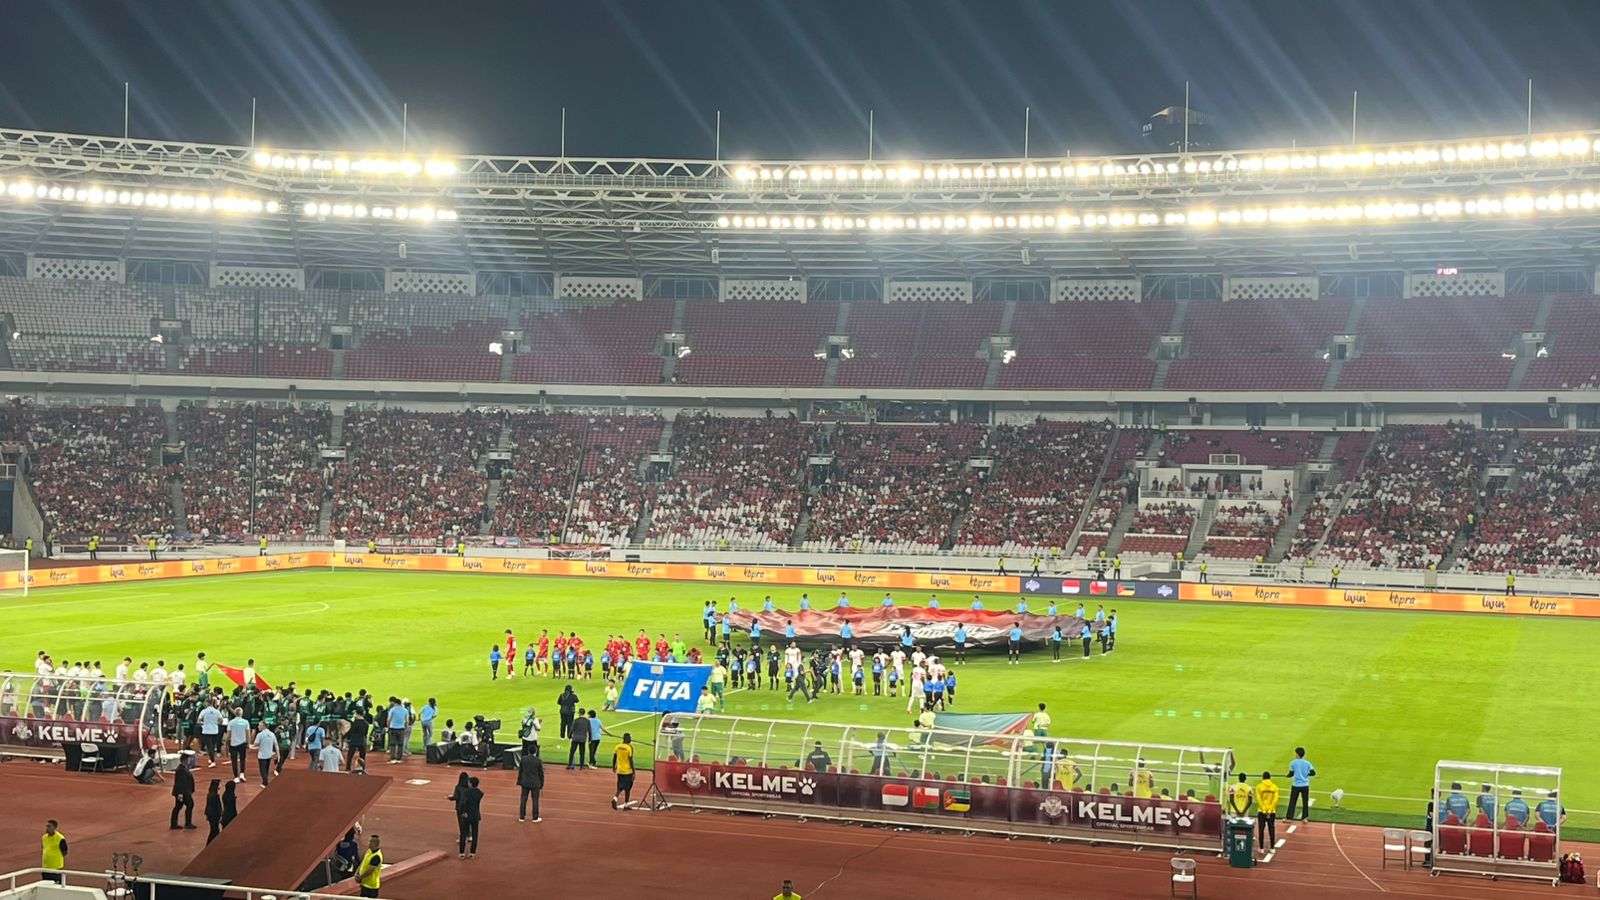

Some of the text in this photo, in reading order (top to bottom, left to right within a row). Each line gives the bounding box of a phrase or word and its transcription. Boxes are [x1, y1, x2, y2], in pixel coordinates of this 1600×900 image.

[633, 679, 691, 700] FIFA
[38, 725, 104, 742] KELME
[715, 771, 797, 793] KELME
[1078, 801, 1172, 825] KELME
